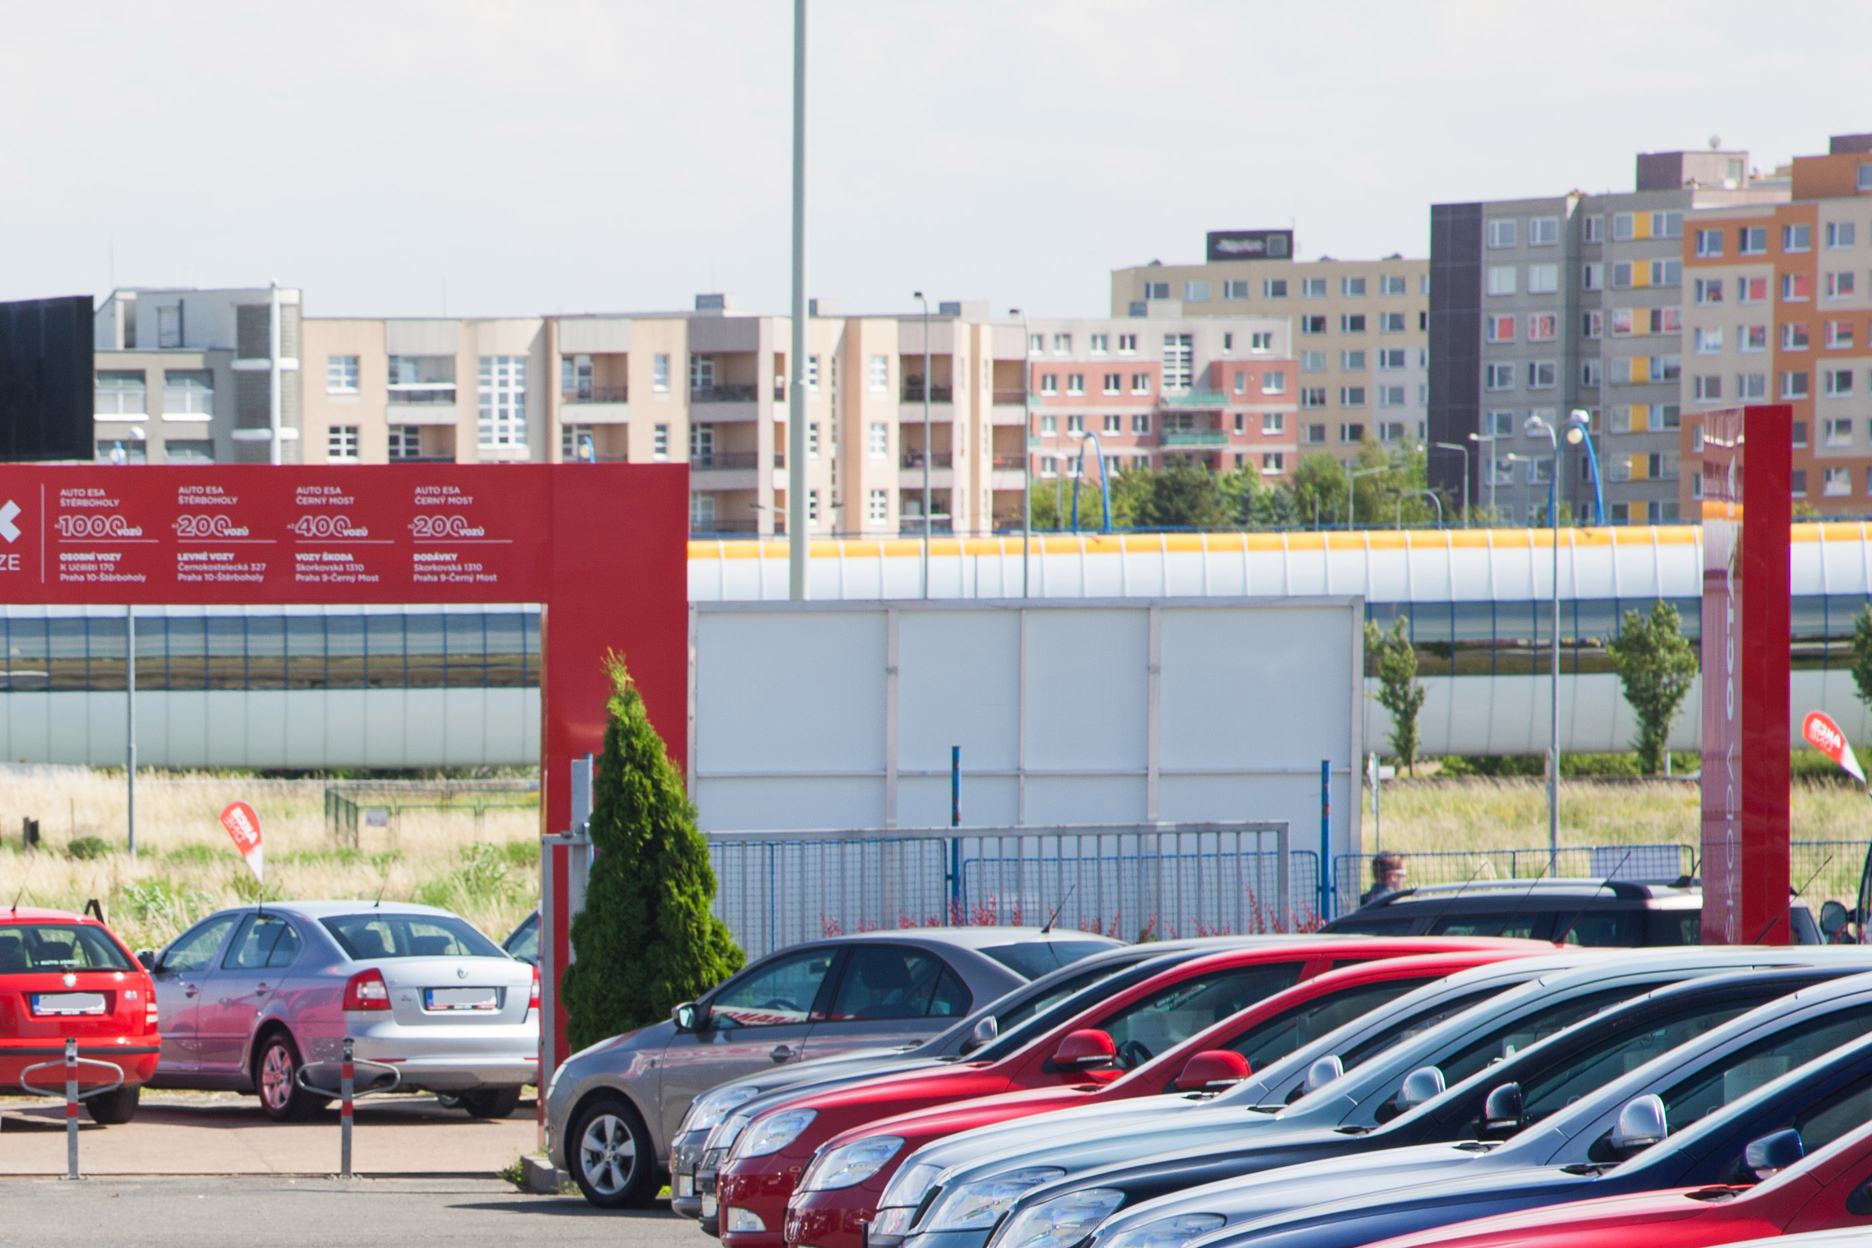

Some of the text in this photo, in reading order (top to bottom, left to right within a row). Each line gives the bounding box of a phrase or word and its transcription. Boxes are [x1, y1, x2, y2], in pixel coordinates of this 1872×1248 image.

[60, 488, 106, 497] AUTO ESA
[178, 486, 224, 494] AUTO ESA
[296, 486, 342, 495] AUTO ESA
[415, 486, 461, 495] AUTO ESA
[296, 495, 355, 505] ČERNÝ MOST
[414, 495, 474, 505] ČERNÝ MOST
[59, 515, 127, 537] 1000
[177, 515, 232, 537] 200
[295, 515, 351, 537] 400
[413, 515, 468, 537] 200
[96, 553, 122, 561] VOZY
[209, 553, 235, 561] VOZY
[295, 551, 354, 561] VOZY ŠKODA
[251, 563, 266, 571] 327
[60, 573, 84, 582] Praha
[177, 573, 203, 582] Praha
[296, 574, 320, 582] Praha
[358, 574, 379, 582] Most
[414, 574, 438, 582] Praha
[476, 574, 497, 582] Most
